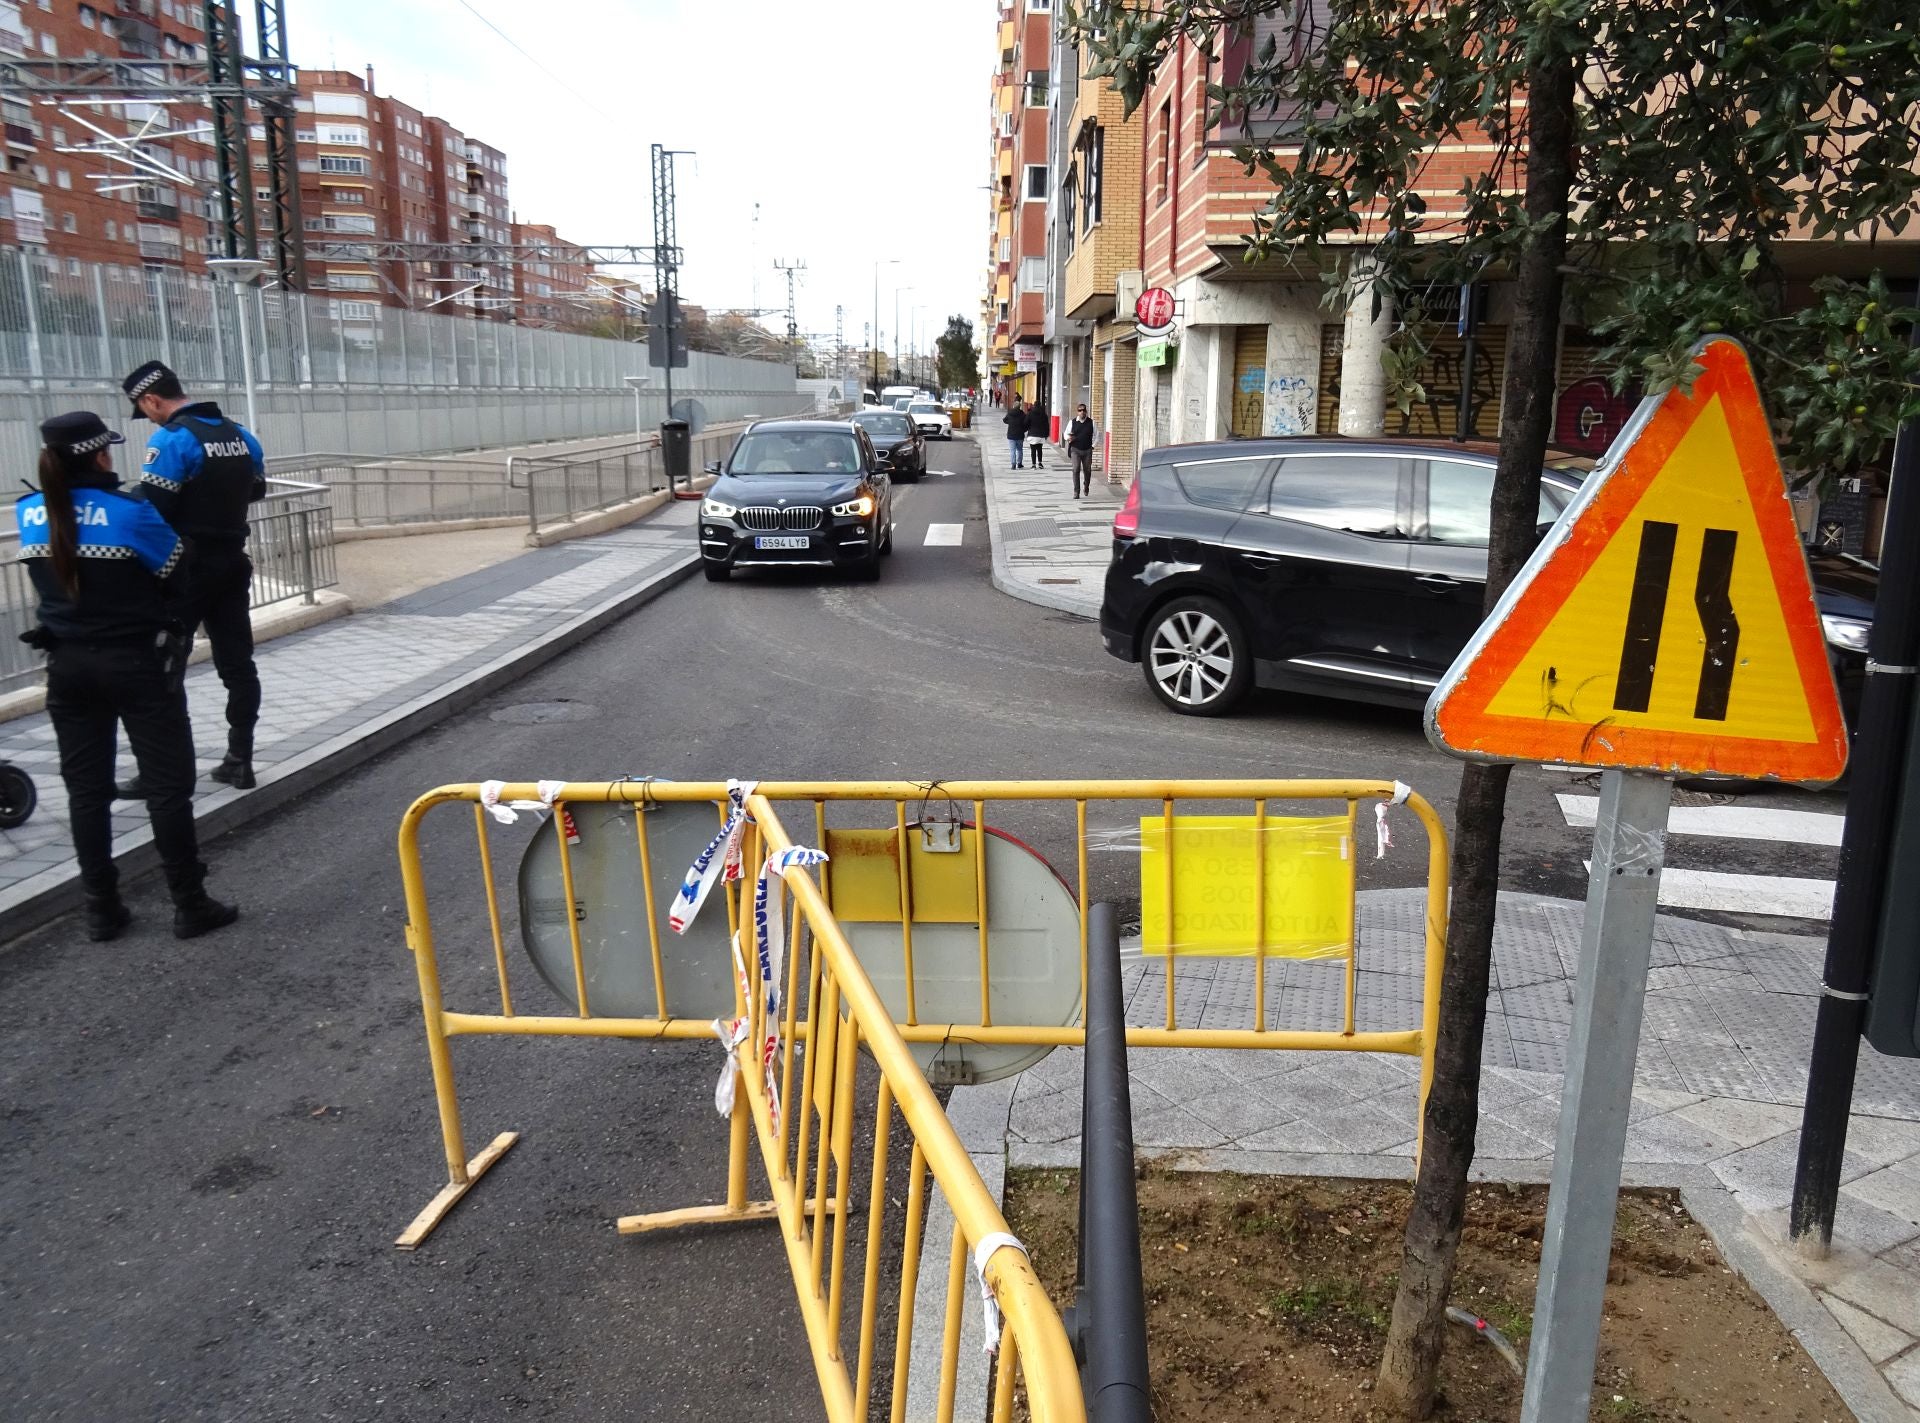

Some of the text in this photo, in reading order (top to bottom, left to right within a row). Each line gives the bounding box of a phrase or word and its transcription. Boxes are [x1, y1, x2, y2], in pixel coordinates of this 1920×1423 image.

[203, 436, 250, 458] POLICÍA
[22, 501, 109, 528] POCÍA
[762, 538, 785, 548] 6594
